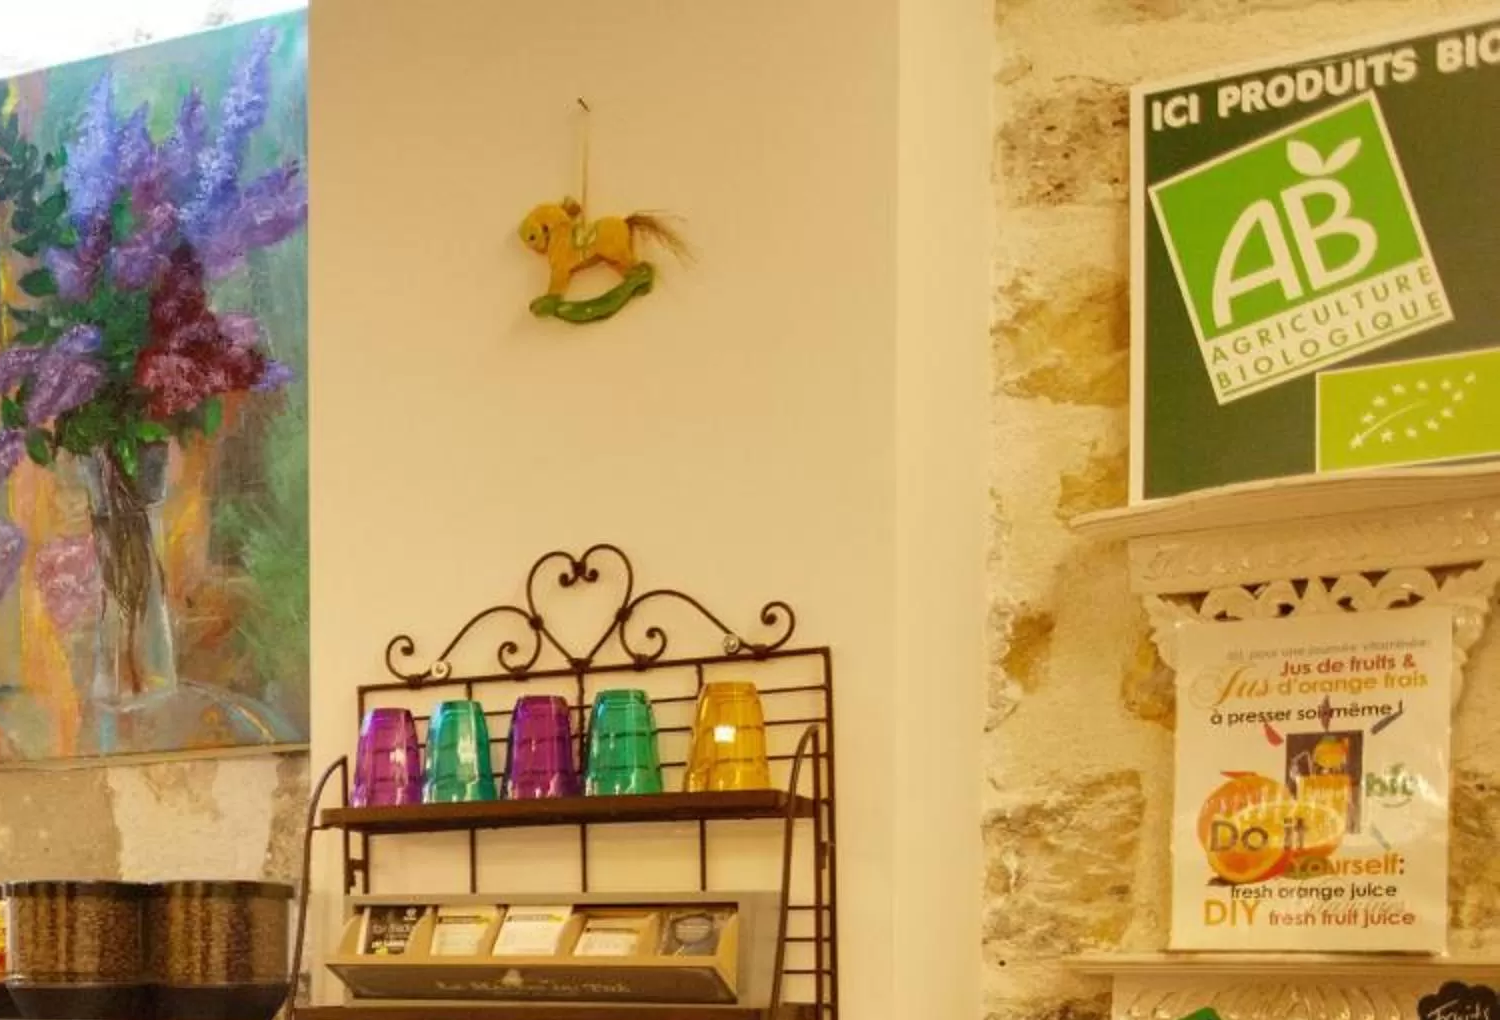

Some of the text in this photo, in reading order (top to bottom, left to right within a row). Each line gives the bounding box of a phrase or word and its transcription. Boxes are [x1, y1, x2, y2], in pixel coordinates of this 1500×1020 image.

[1151, 30, 1500, 131] ICI PRODUITS BIO
[1211, 178, 1379, 328] AB
[1210, 264, 1434, 364] AGRICULTURE
[1216, 291, 1444, 390] BIOLOGIQUE
[1279, 653, 1416, 678] Jus de fruits &
[1276, 674, 1379, 697] d'orange
[1383, 670, 1429, 689] frais
[1210, 709, 1223, 725] à
[1227, 707, 1291, 726] presser
[1209, 817, 1308, 853] Do it
[1230, 882, 1397, 902] fresh orange juice
[1204, 898, 1417, 929] DIY fresh fruit juice
